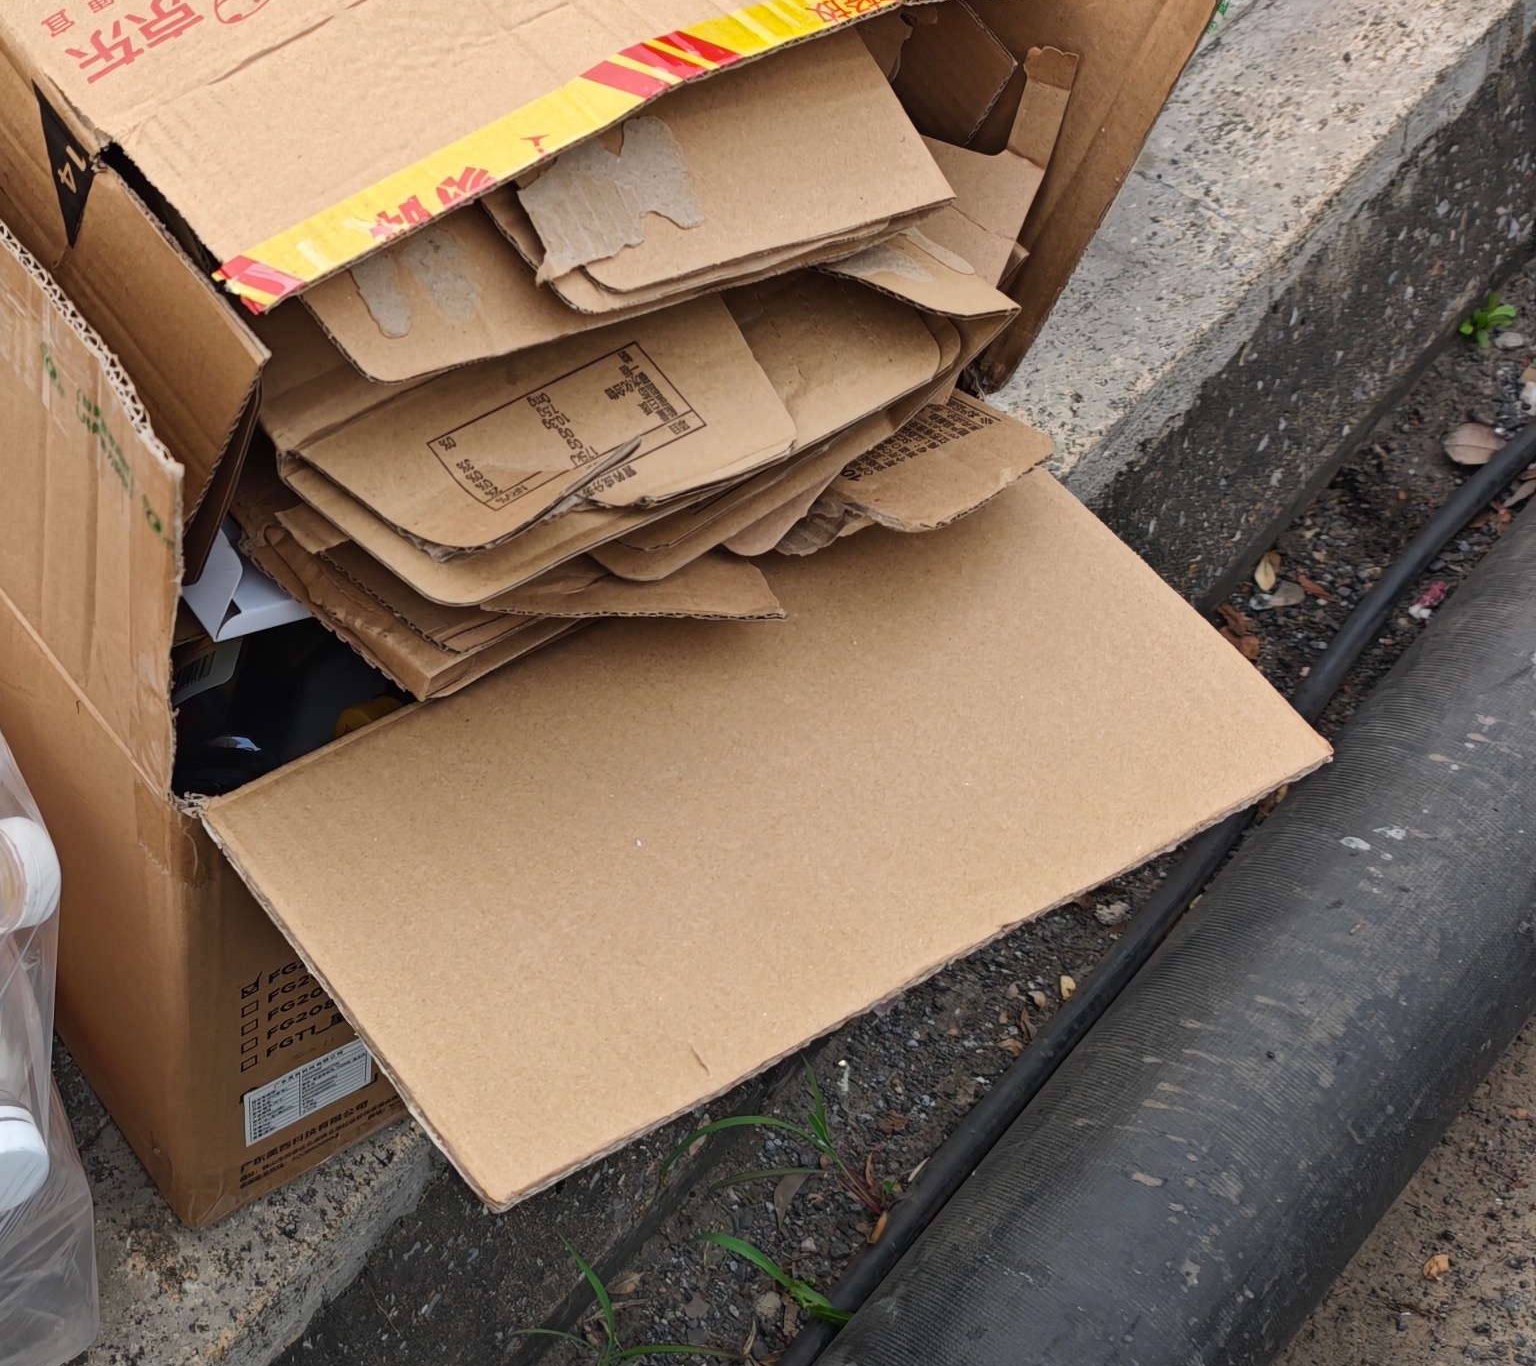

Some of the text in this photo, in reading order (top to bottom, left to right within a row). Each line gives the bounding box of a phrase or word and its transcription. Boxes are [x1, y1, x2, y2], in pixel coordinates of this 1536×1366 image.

[58, 146, 87, 193] 14
[438, 436, 456, 451] 0%
[456, 459, 474, 473] 3%
[465, 471, 484, 483] 0%
